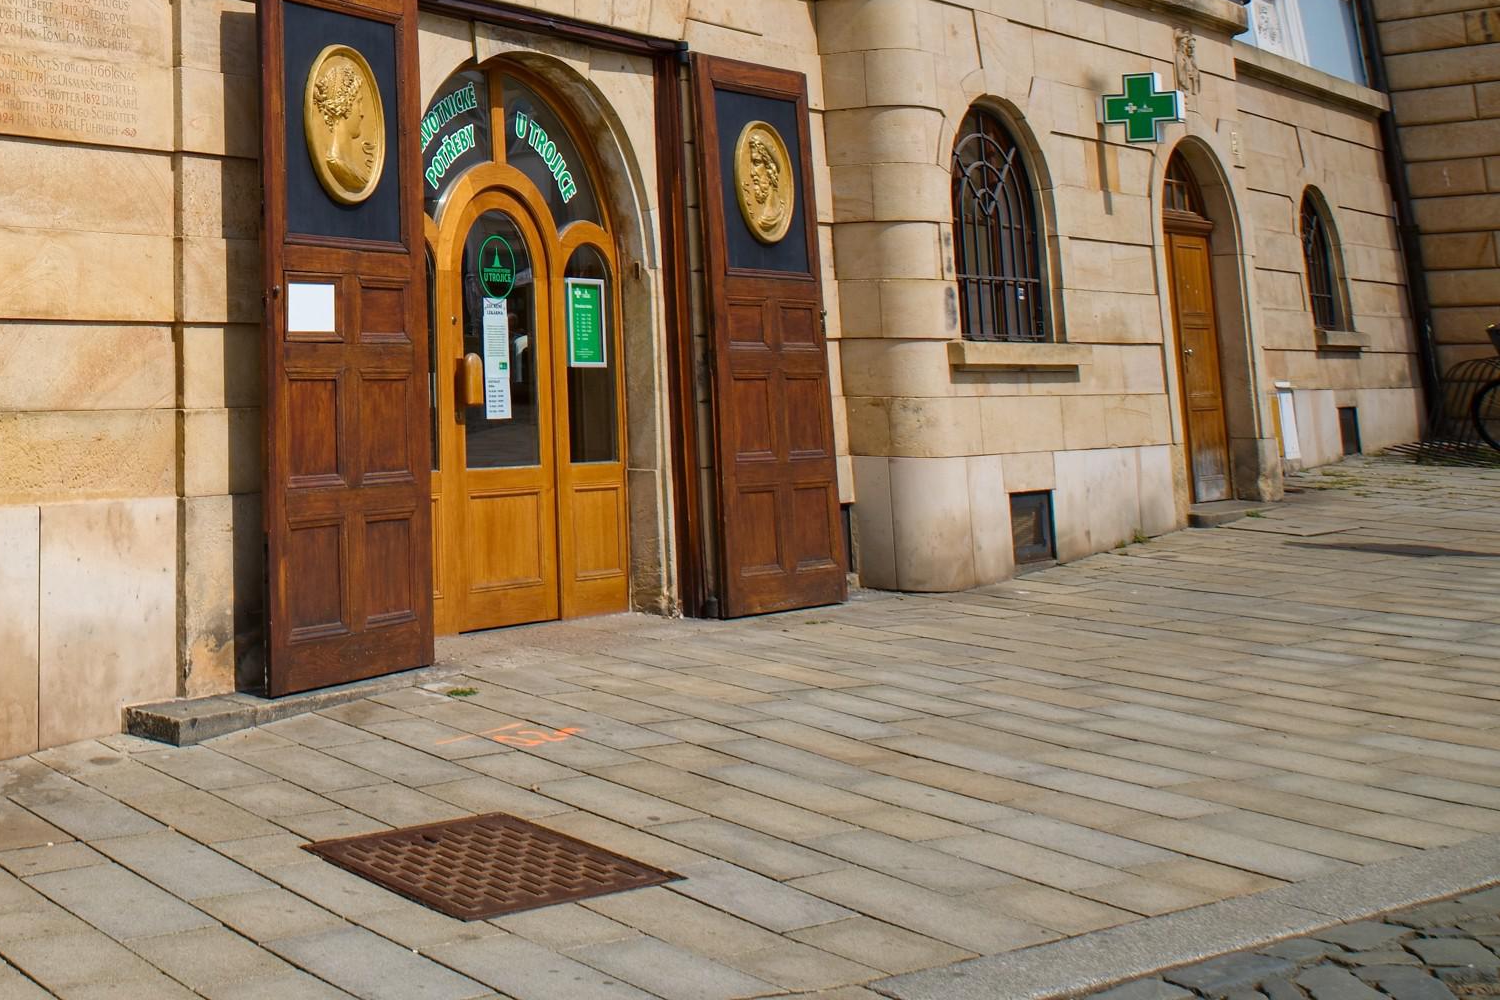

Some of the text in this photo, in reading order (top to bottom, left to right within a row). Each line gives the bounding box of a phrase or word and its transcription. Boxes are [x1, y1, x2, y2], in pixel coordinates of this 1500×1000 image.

[421, 82, 477, 154] AVOTNICKÉ
[425, 124, 476, 190] POTŘEBY
[515, 111, 577, 204] U TROJICE
[489, 273, 512, 283] TROJICE
